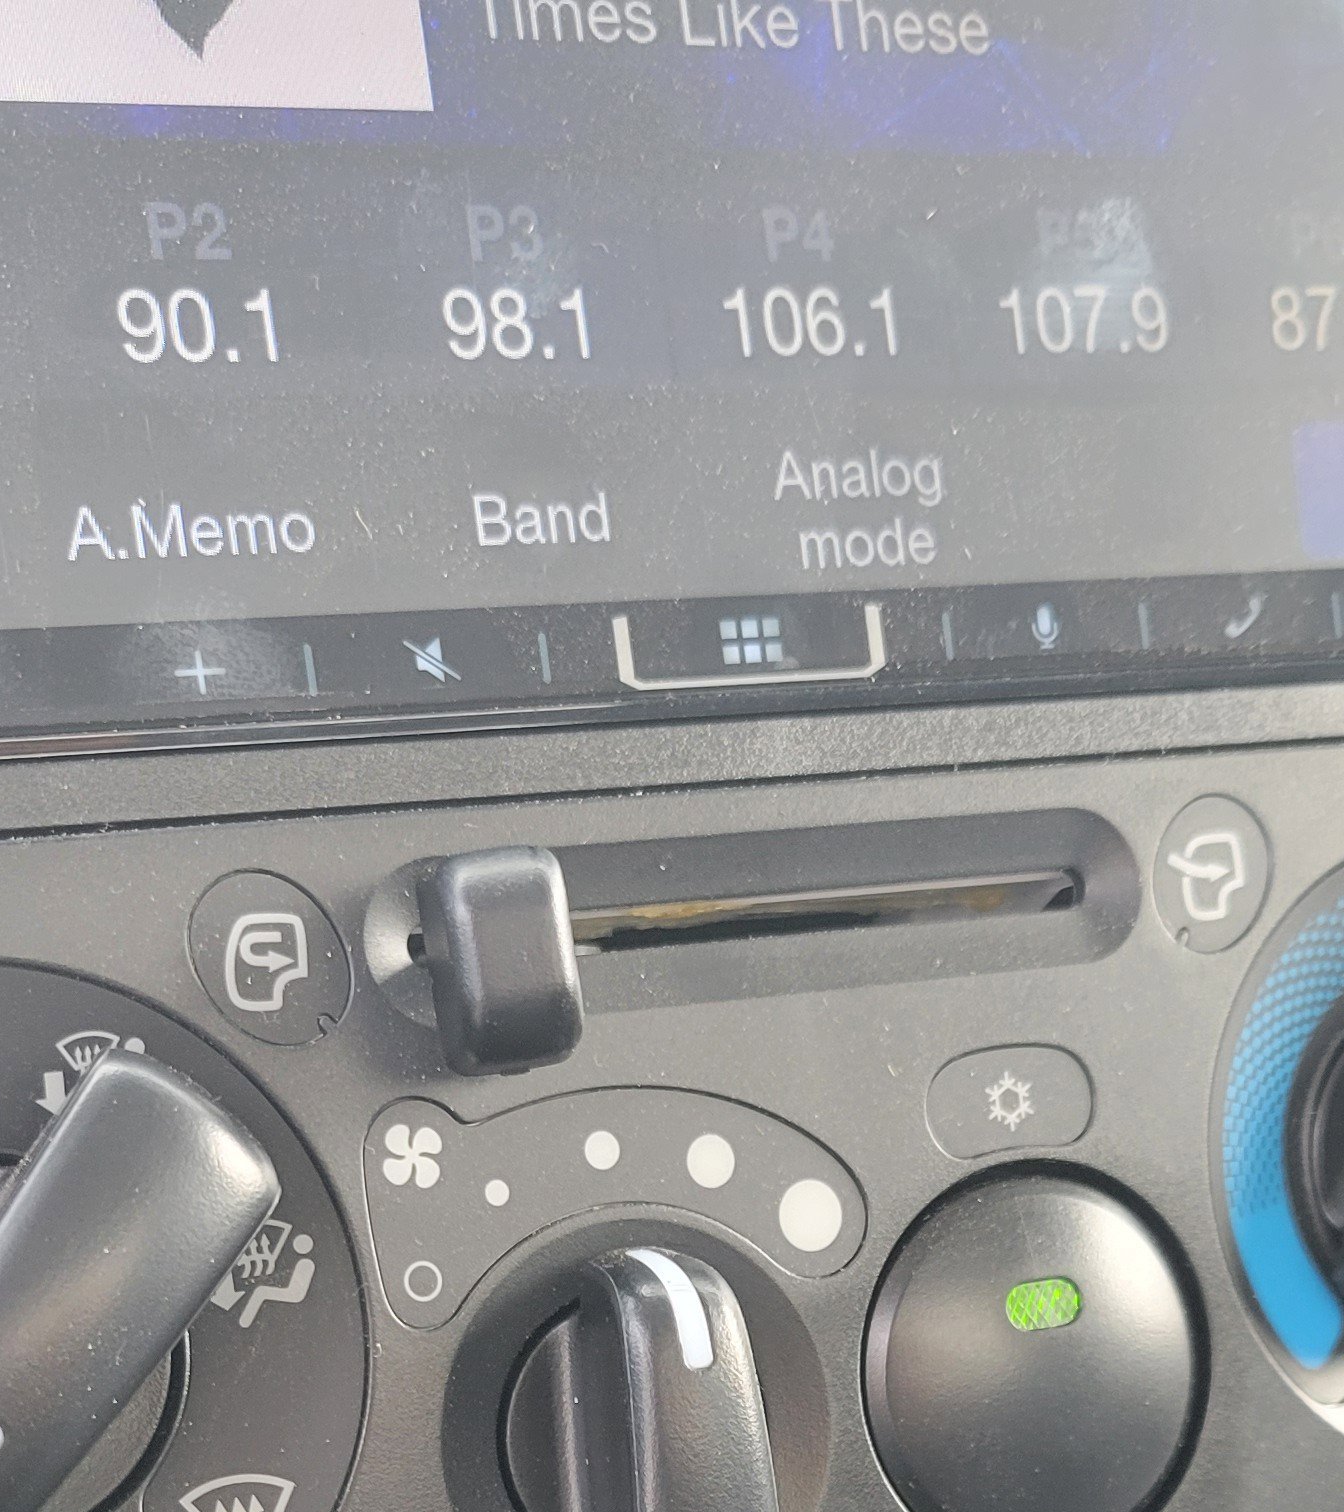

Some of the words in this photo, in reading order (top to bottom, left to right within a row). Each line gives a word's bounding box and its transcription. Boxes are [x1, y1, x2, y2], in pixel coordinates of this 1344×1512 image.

[483, 0, 657, 45] Times
[678, 0, 800, 49] Like
[827, 0, 993, 56] These
[147, 203, 233, 262] P2
[465, 203, 547, 263] P3
[762, 209, 835, 263] P4
[116, 287, 279, 364] 90.1
[441, 287, 594, 361] 98.1
[721, 285, 901, 358] 106.1
[999, 283, 1170, 355] 107.9
[773, 449, 945, 506] Analog
[67, 503, 317, 564] A.Memo
[472, 487, 613, 547] Band
[799, 516, 938, 571] mode
